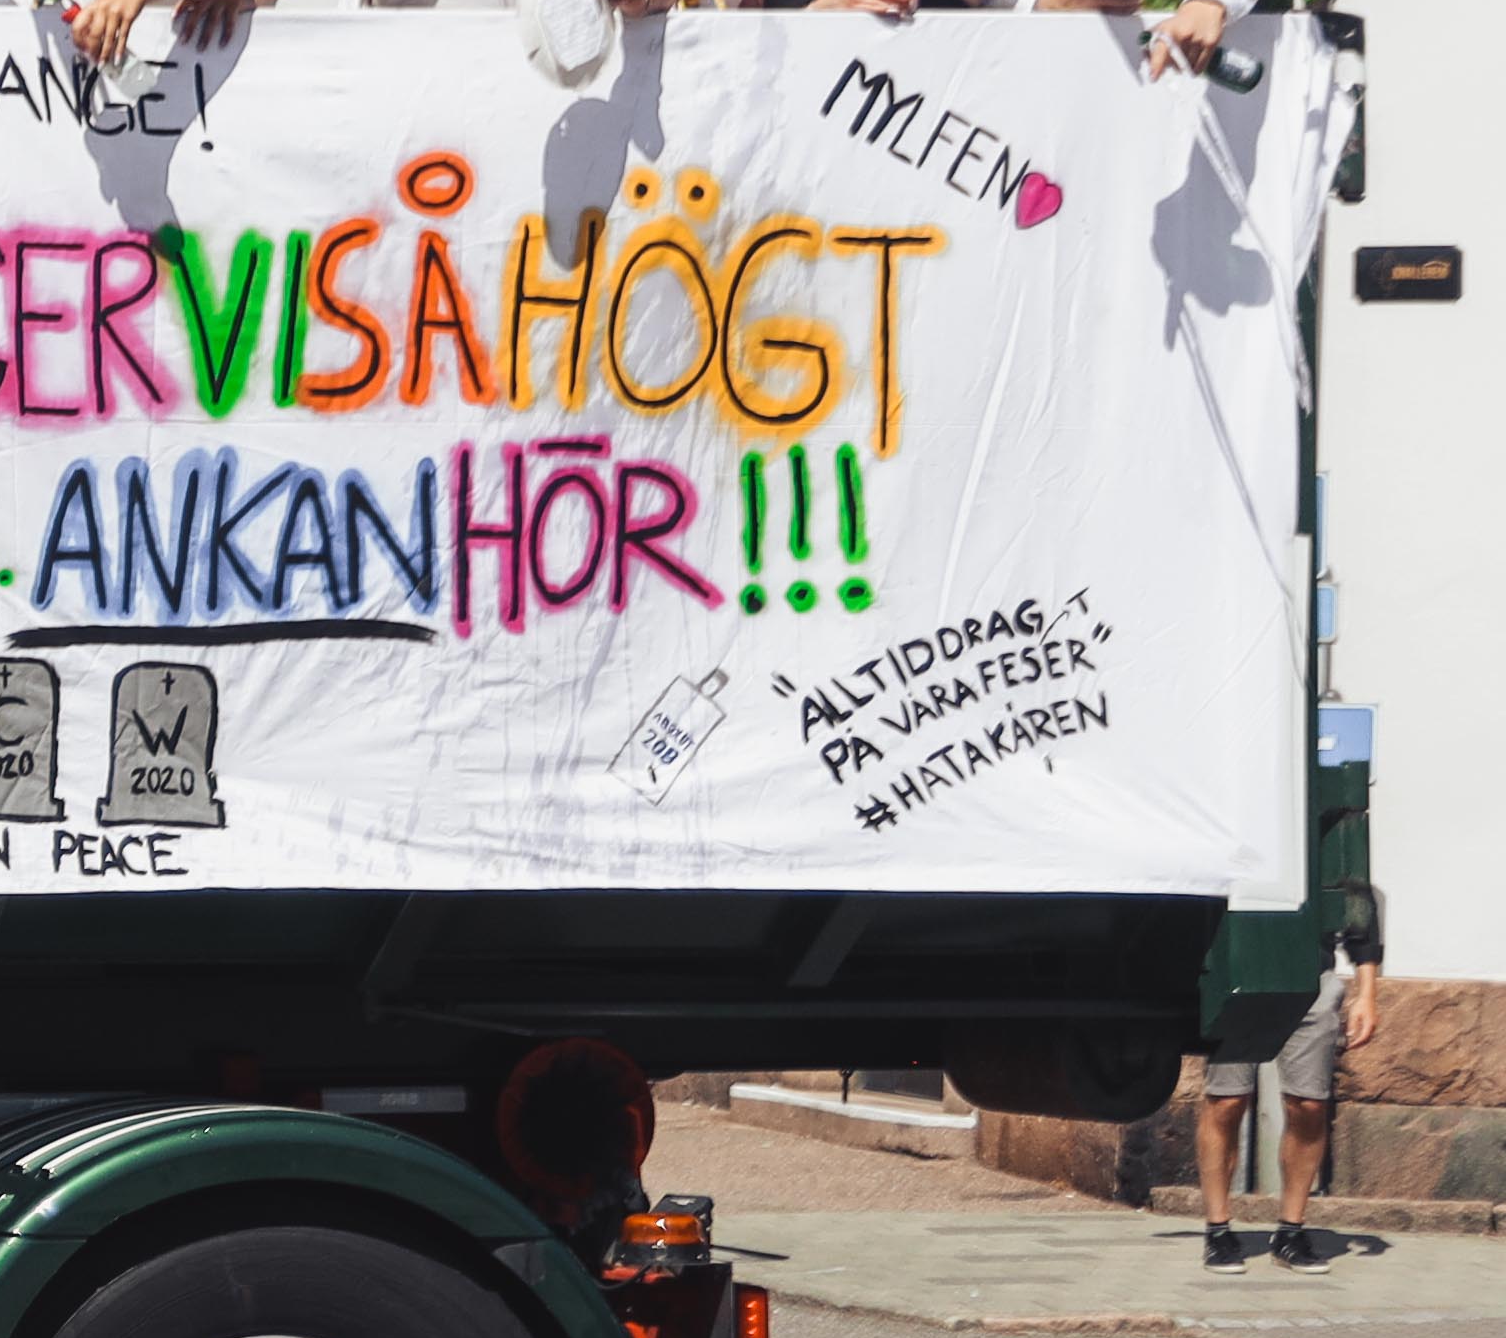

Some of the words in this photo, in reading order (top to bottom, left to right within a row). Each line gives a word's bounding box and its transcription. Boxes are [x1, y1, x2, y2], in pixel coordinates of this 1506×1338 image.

[160, 223, 314, 418] VI
[298, 148, 497, 413] SÅ
[497, 166, 948, 457] HÖGT
[27, 445, 439, 621] ANKAN
[132, 706, 190, 758] W
[130, 764, 197, 798] 2020
[52, 831, 188, 876] PEACE
